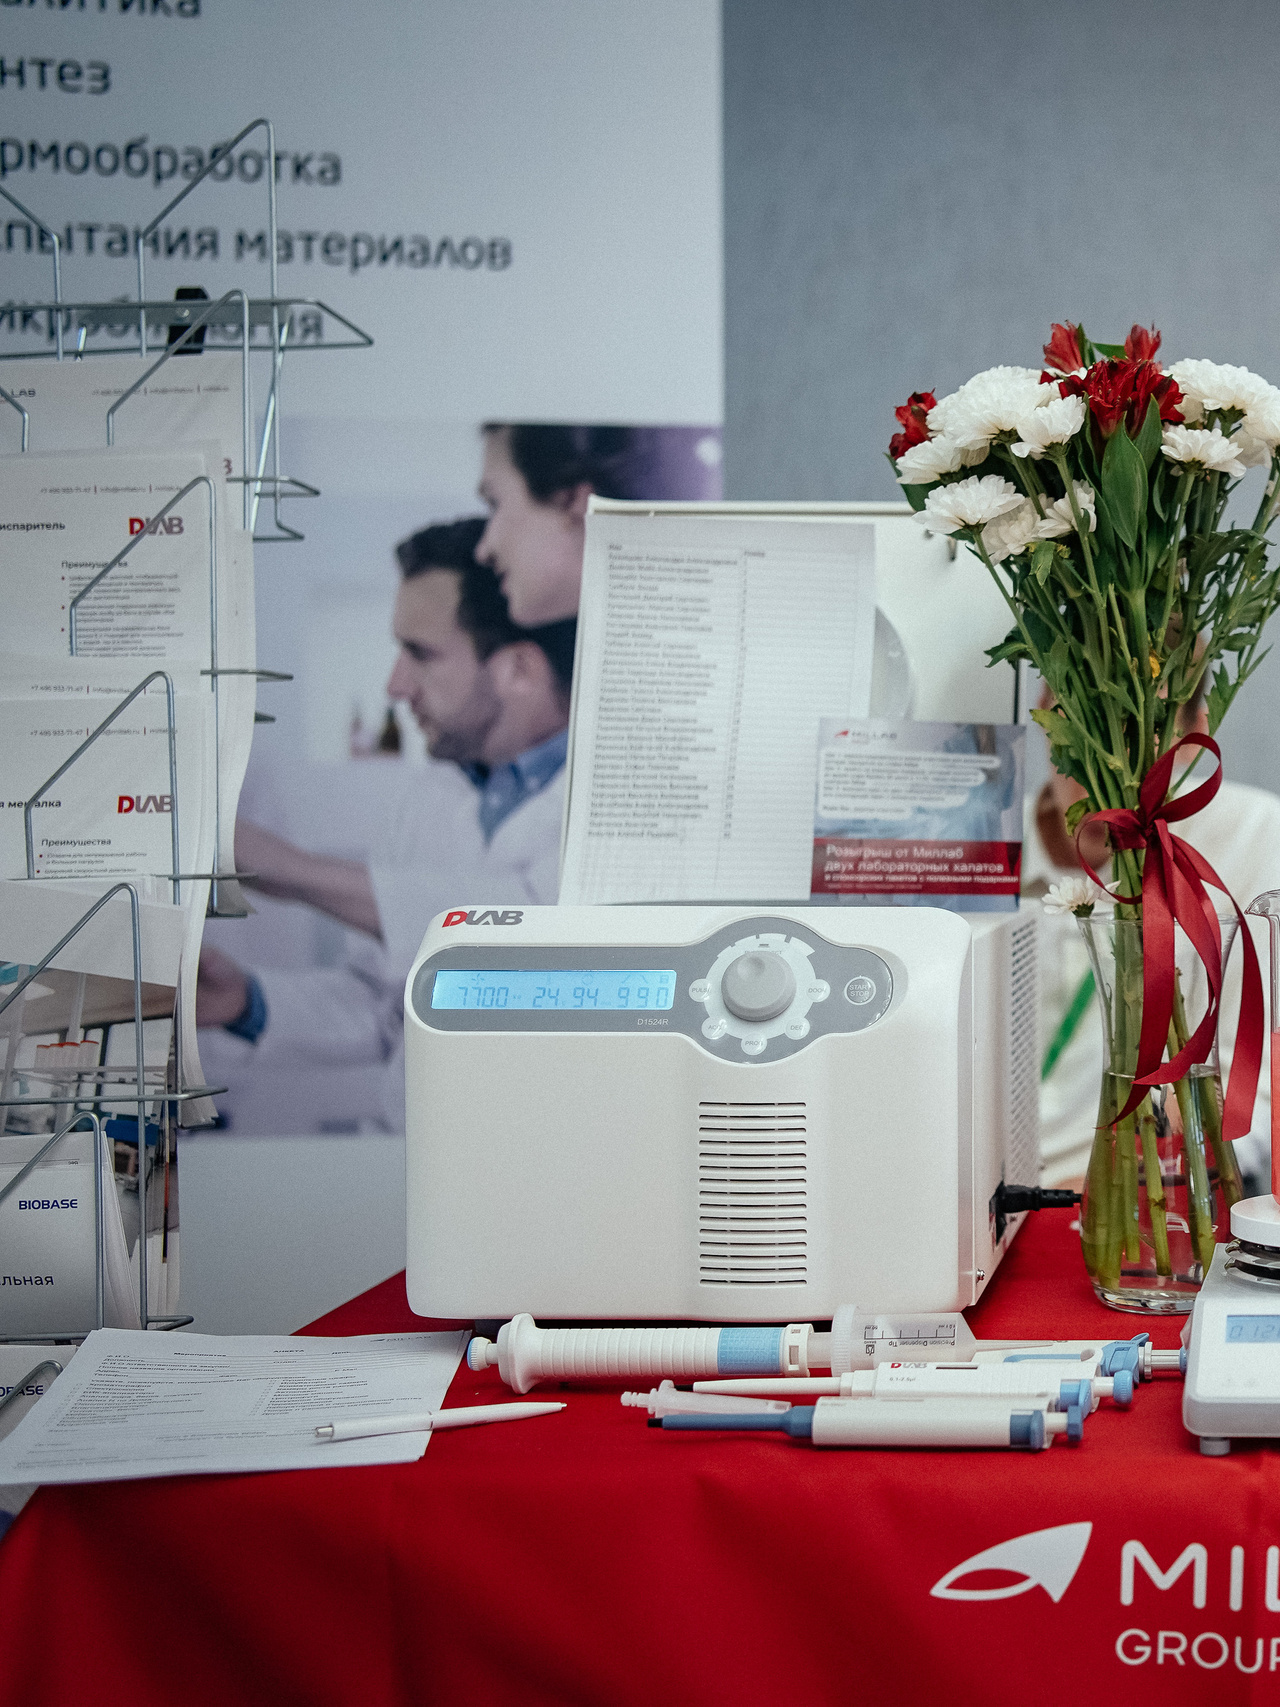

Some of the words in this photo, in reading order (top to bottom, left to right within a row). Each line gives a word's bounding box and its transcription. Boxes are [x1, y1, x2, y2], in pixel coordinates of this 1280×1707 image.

[0, 219, 220, 261] пытания
[235, 228, 512, 274] материалов
[8, 799, 61, 809] меалка
[118, 795, 174, 814] DLAB
[41, 838, 112, 848] Преимущества
[442, 910, 524, 928] DLAB
[458, 986, 509, 1007] 7700
[532, 986, 560, 1008] 24
[572, 986, 600, 1008] 94
[637, 1018, 669, 1026] D1524R
[19, 1199, 78, 1209] BIOBASE
[0, 1276, 54, 1286] льная
[899, 1339, 928, 1347] Dispenser
